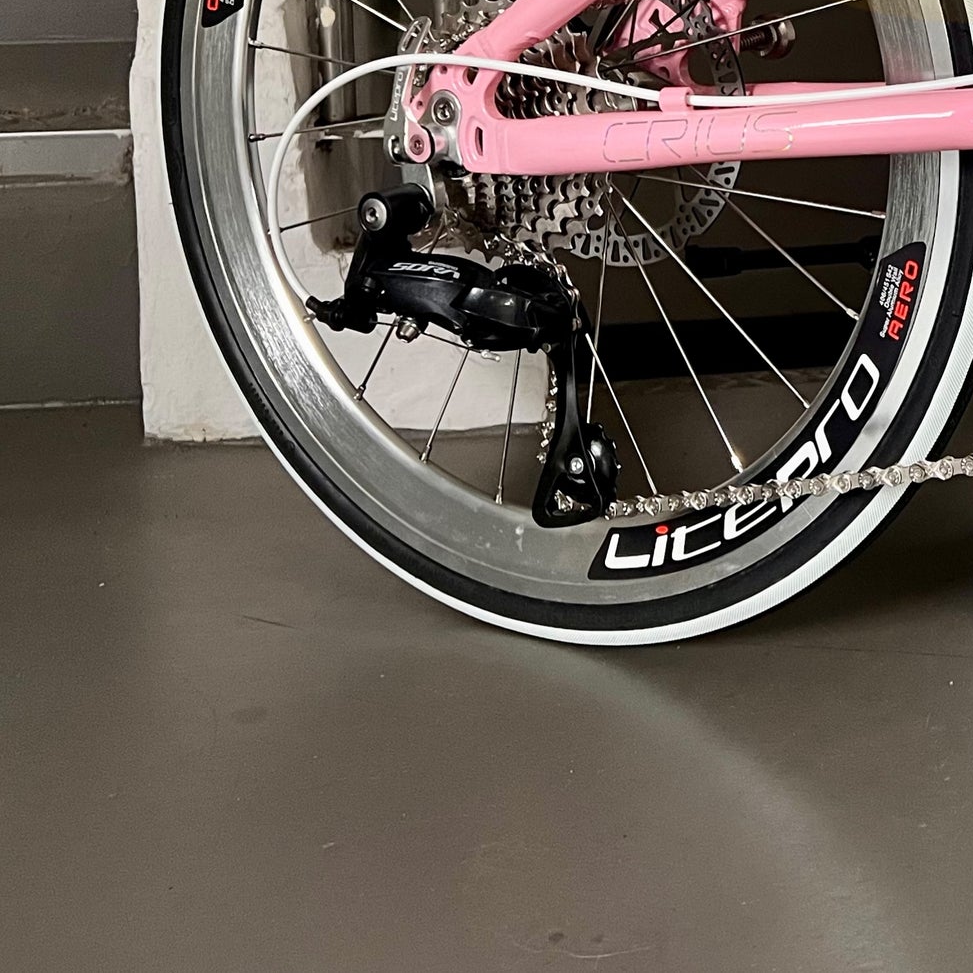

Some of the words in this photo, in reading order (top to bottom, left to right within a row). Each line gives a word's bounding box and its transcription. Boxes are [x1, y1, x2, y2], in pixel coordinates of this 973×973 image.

[602, 111, 798, 163] CRIUS
[387, 262, 461, 279] SORA
[888, 260, 918, 341] AERO
